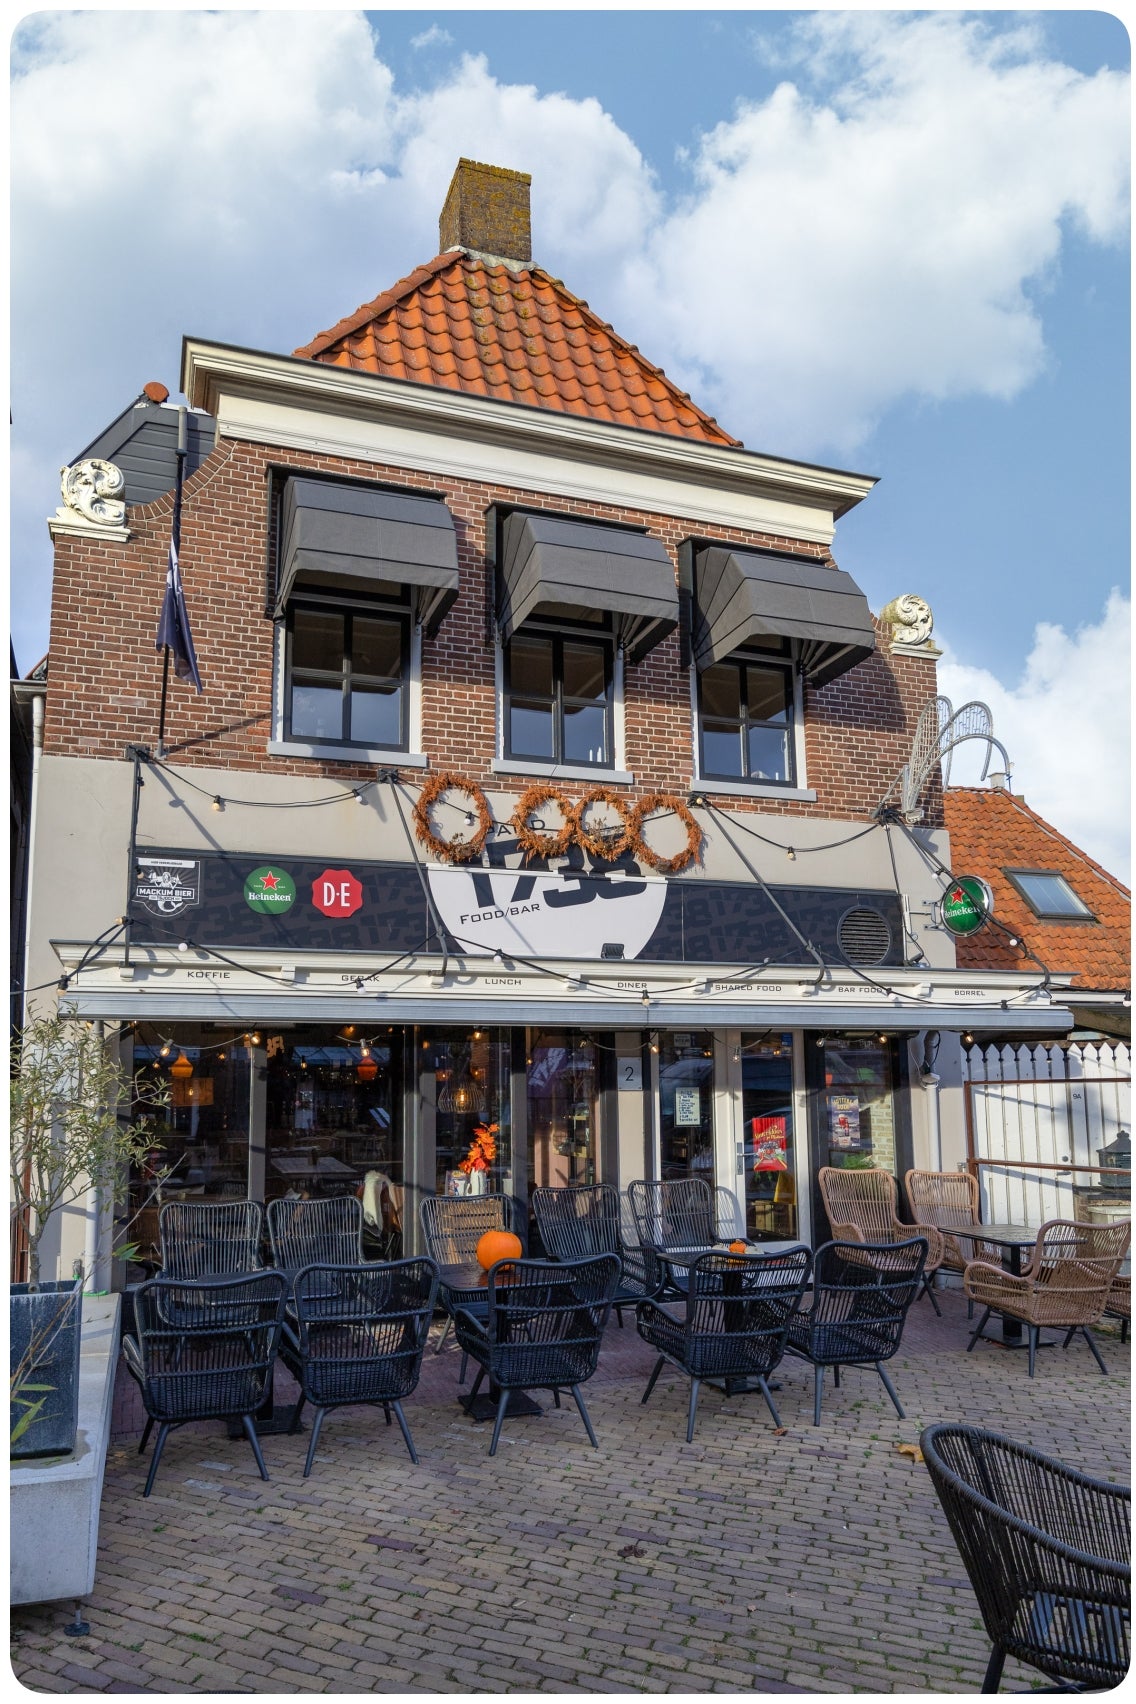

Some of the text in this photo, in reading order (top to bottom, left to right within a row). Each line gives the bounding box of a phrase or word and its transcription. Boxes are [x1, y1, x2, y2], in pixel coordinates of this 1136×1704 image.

[139, 888, 173, 896] MACKUM
[248, 892, 292, 902] Heineken
[460, 903, 541, 925] FOOD/BAR
[187, 971, 231, 979] KOFFIE
[484, 978, 522, 986] LUNCH
[617, 981, 648, 989] DINER
[715, 984, 782, 992] SHARED FOOD
[624, 1066, 635, 1082] 2
